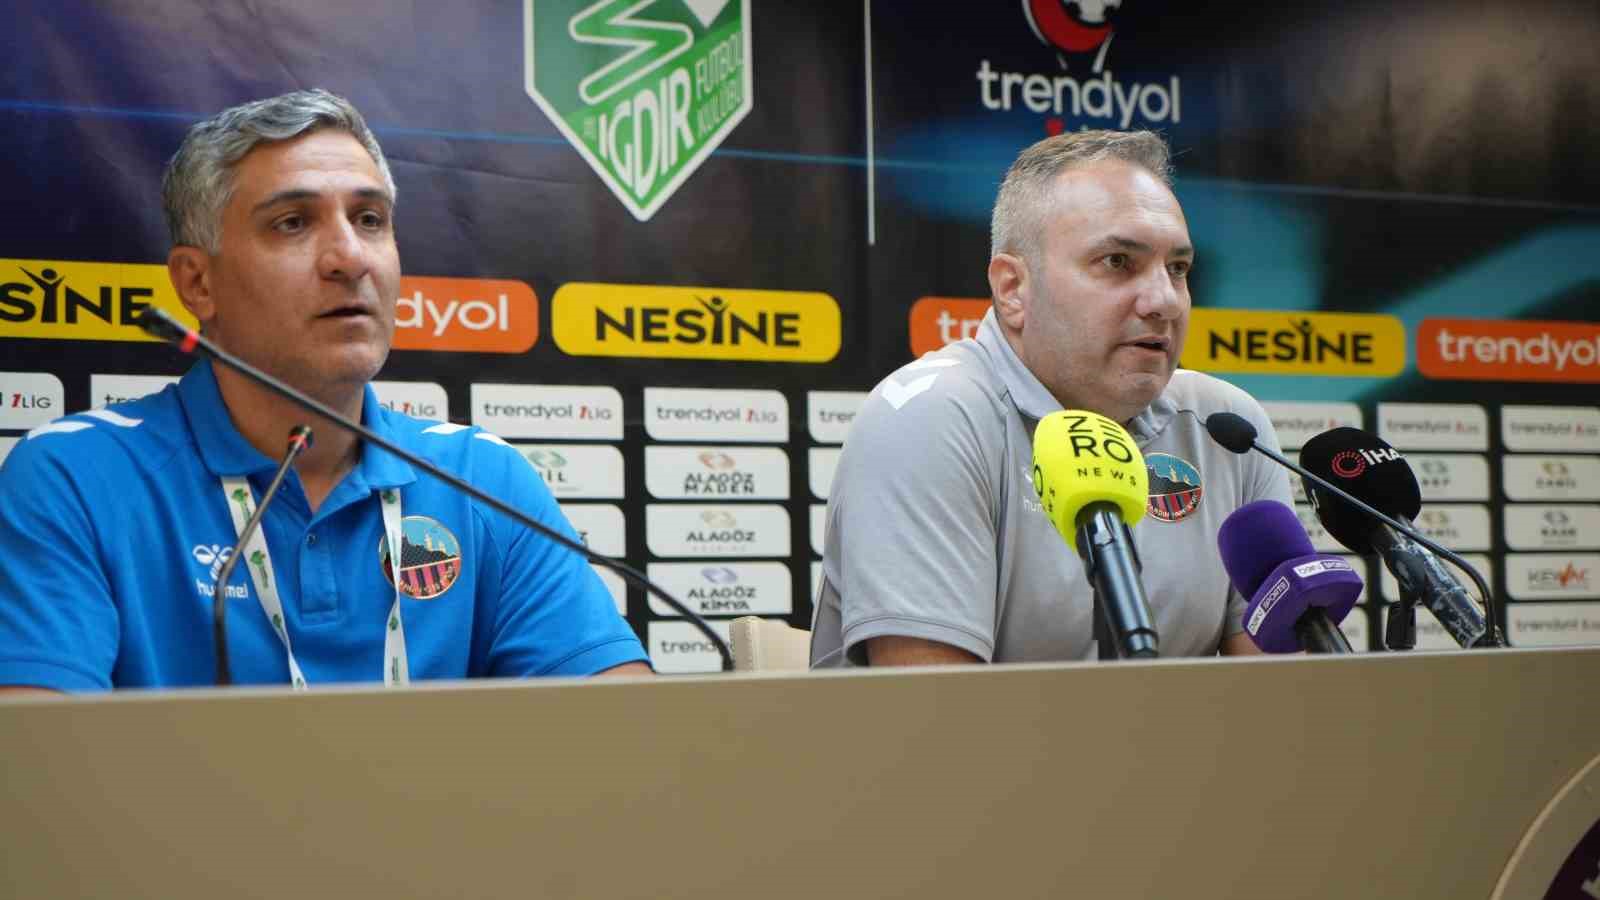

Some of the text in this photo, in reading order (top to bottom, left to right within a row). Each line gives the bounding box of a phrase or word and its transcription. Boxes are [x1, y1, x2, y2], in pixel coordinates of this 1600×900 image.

[976, 59, 1181, 129] trendyol
[483, 402, 573, 420] trendyol
[655, 406, 741, 423] trendyol
[1077, 468, 1137, 487] NEWS
[684, 481, 755, 494] MADEN
[196, 578, 249, 598] humel
